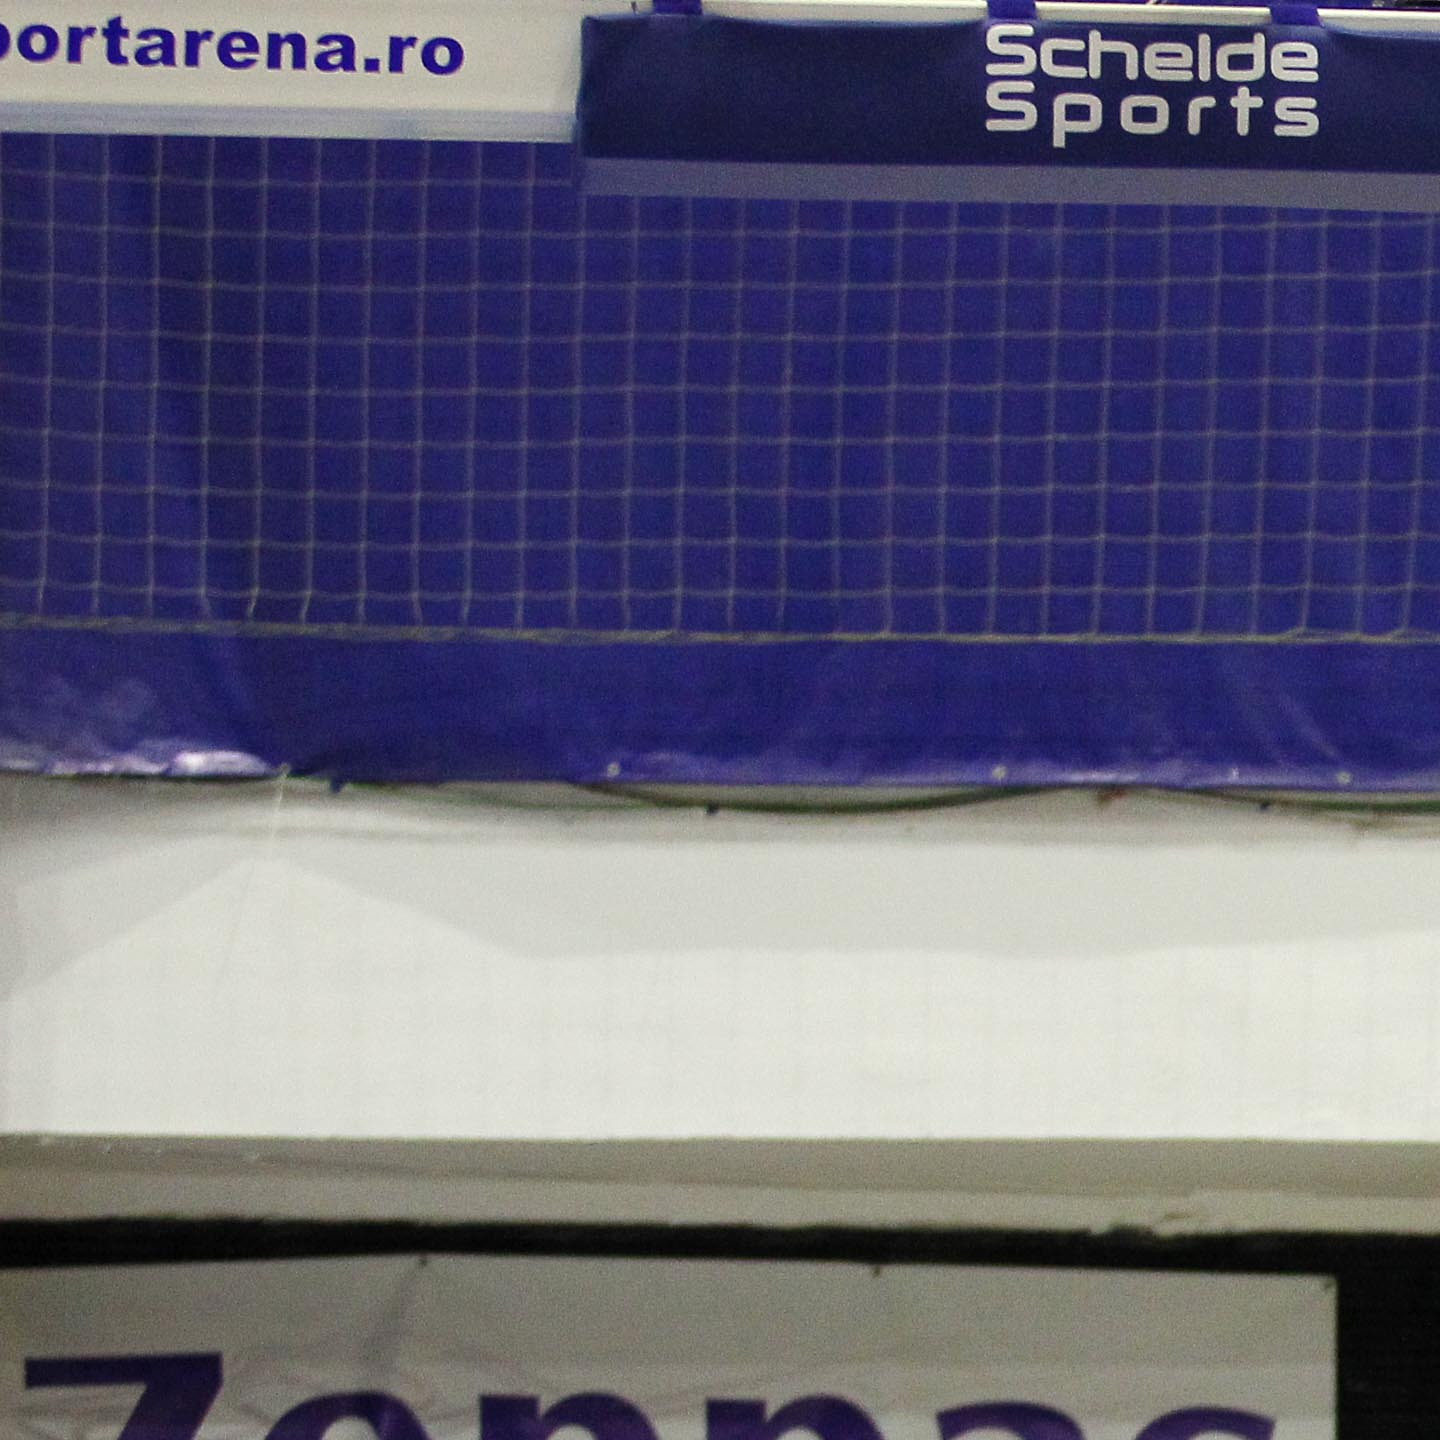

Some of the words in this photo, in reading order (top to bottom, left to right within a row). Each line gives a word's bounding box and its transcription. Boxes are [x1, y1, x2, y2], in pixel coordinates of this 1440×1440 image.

[0, 15, 465, 76] ortarena.ro
[985, 23, 1320, 82] Schelde
[985, 80, 1320, 148] Sports
